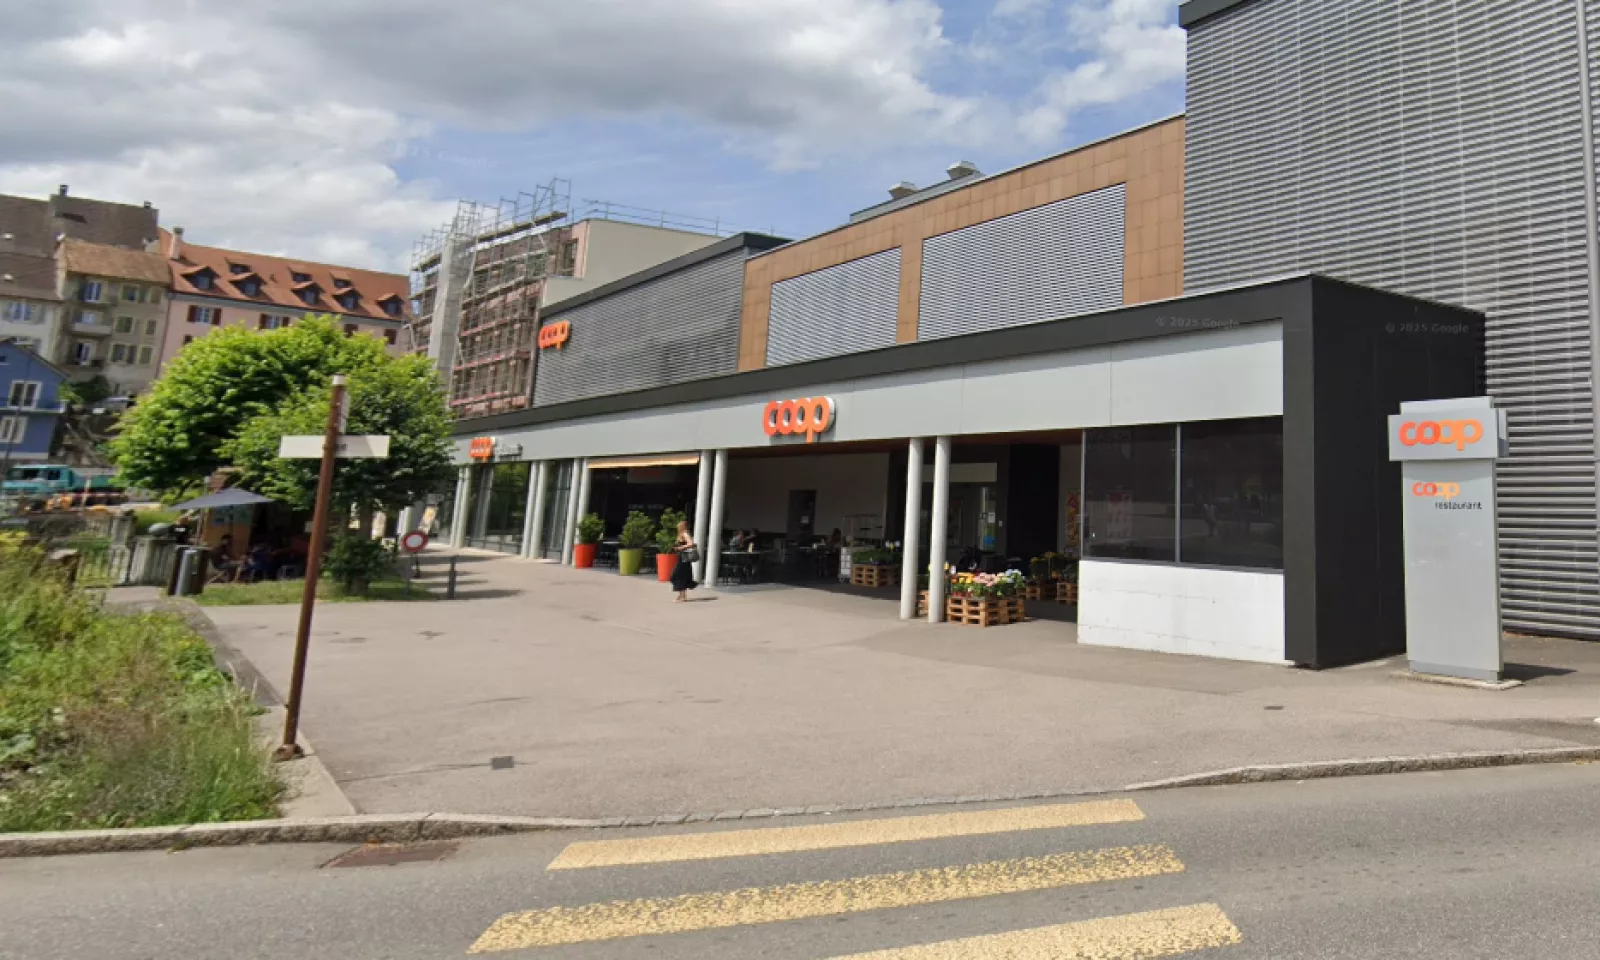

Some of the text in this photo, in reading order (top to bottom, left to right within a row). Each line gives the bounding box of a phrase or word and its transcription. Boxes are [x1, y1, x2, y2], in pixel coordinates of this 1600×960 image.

[763, 396, 833, 444] coop
[1399, 419, 1484, 451] coop
[1412, 482, 1460, 501] coop
[1435, 502, 1482, 510] restaurant
